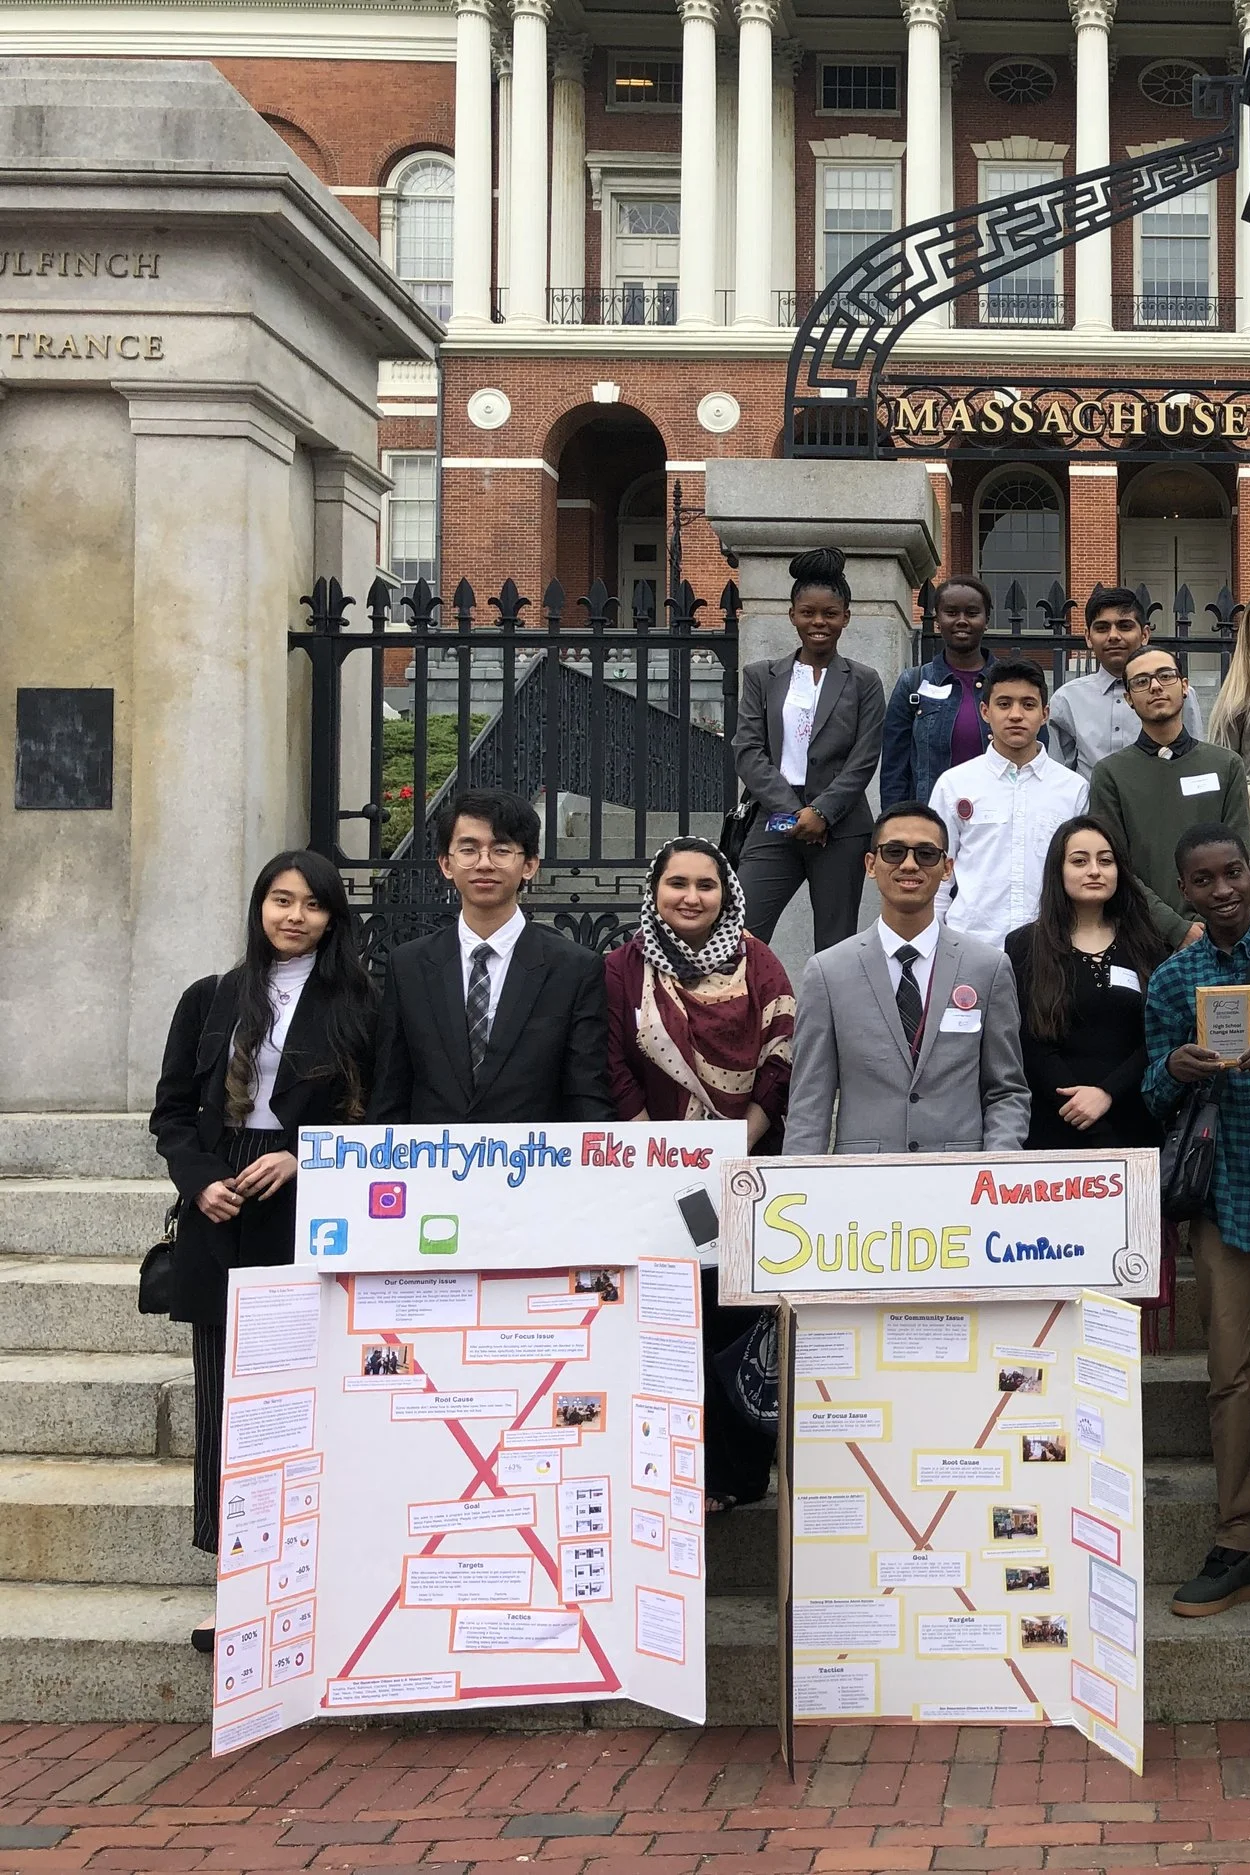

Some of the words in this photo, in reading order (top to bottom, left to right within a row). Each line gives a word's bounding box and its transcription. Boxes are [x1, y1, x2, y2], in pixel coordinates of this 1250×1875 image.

[581, 1131, 636, 1168] Fake
[647, 1137, 713, 1170] News
[398, 1278, 437, 1286] Community
[904, 1314, 945, 1322] Community
[463, 1502, 480, 1510] Goal
[458, 1562, 484, 1570] Targets
[241, 1629, 258, 1642] 100%
